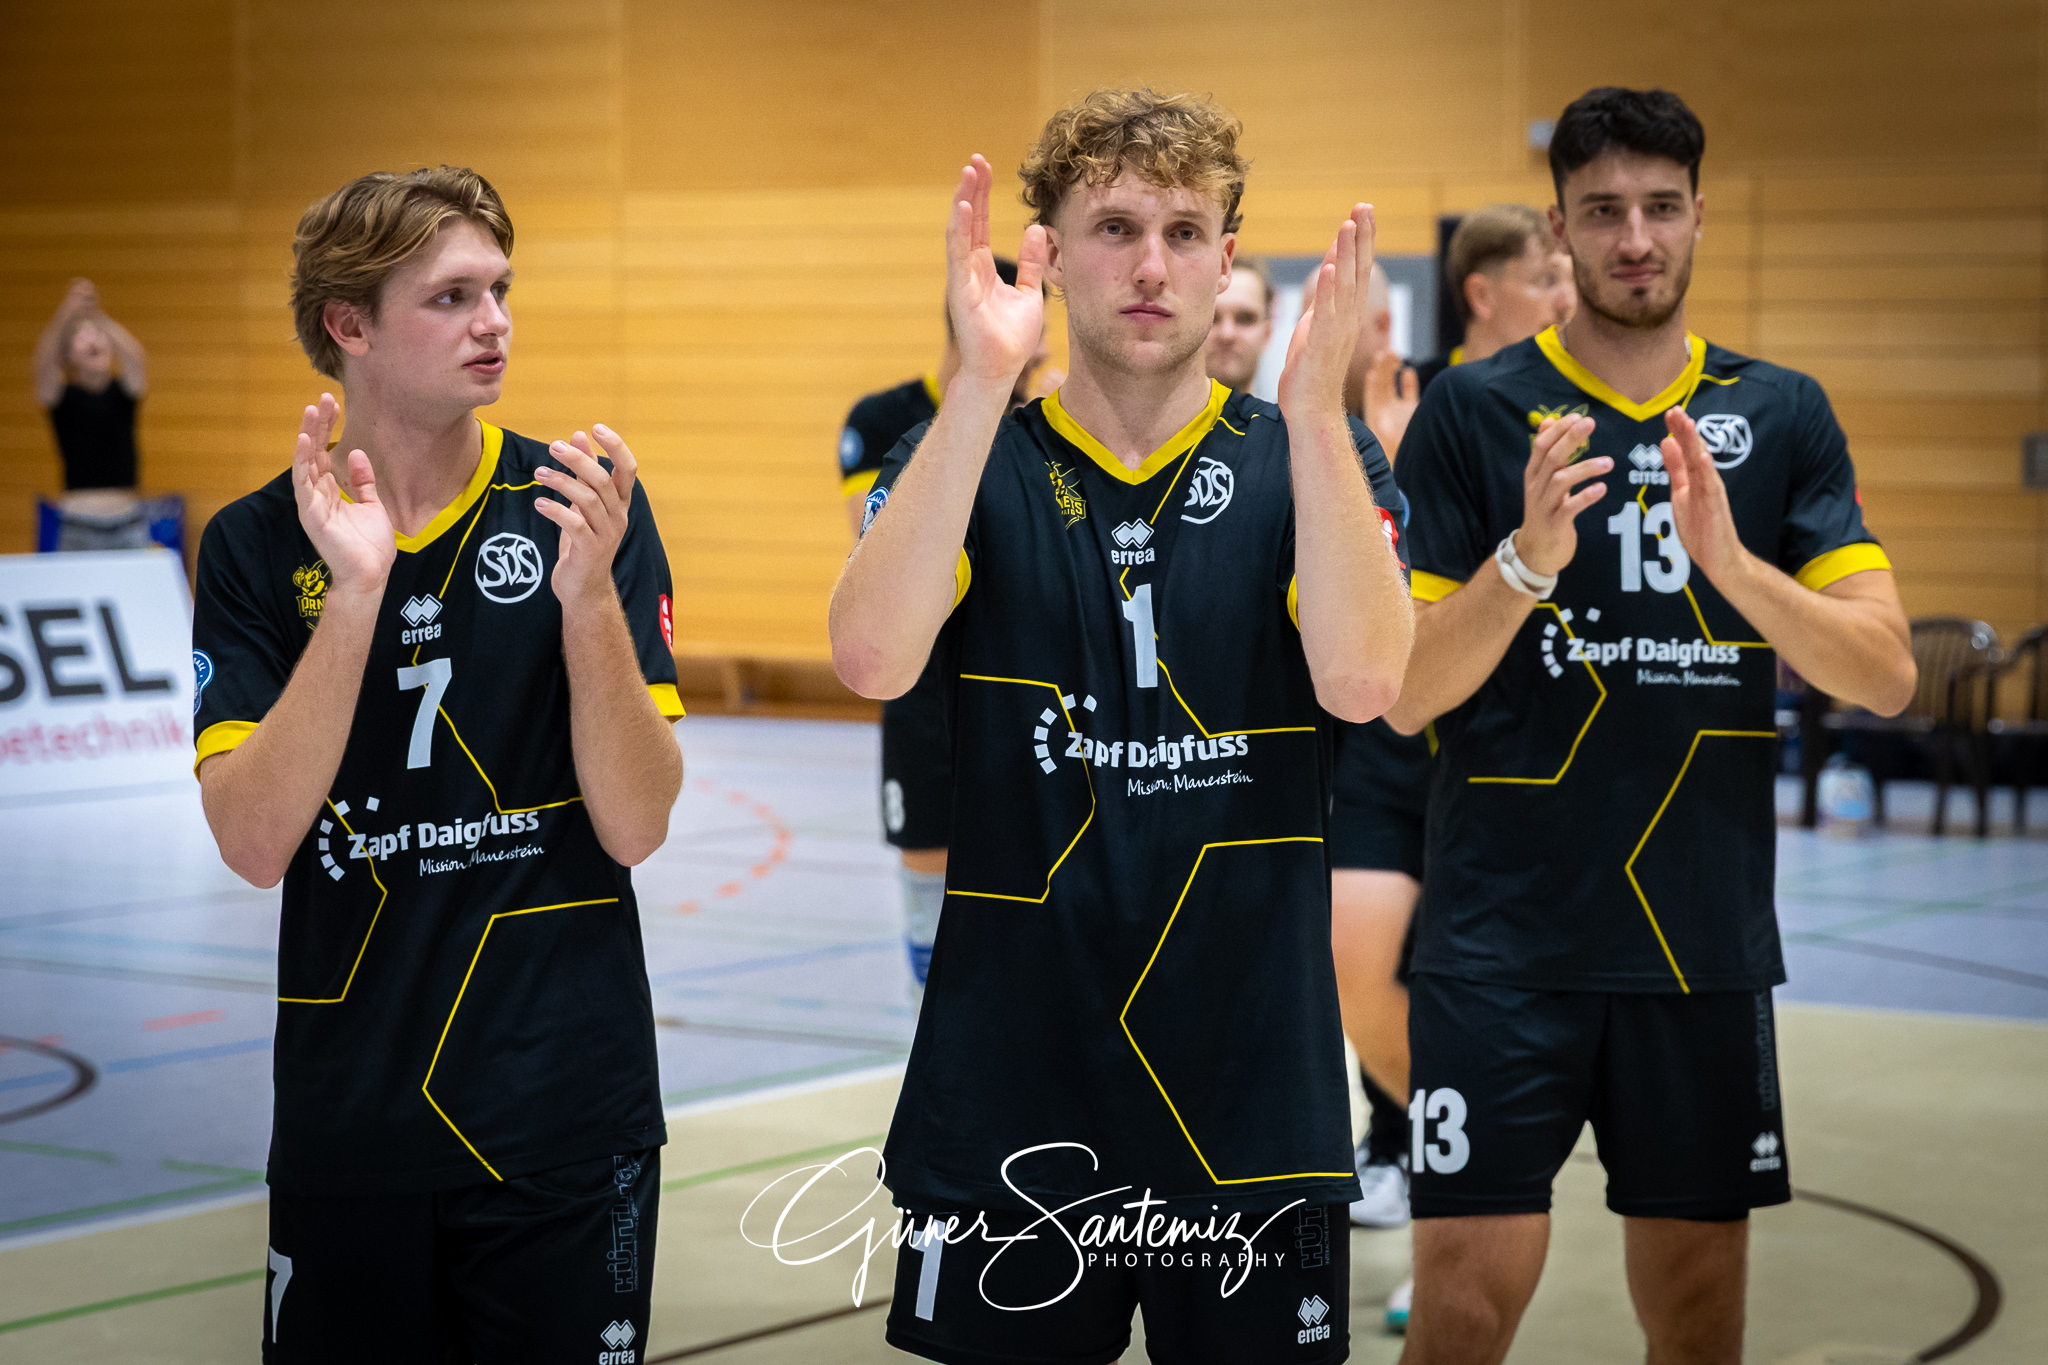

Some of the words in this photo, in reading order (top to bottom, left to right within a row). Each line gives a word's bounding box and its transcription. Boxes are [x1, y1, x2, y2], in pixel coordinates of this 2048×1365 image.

[1608, 501, 1691, 594] 13
[1121, 583, 1158, 688] 1
[1566, 637, 1633, 667] Zapf
[1636, 637, 1741, 668] Daigfuss
[0, 712, 190, 765] etechnik
[396, 657, 452, 770] 7
[1064, 731, 1124, 768] Zapf
[1127, 734, 1249, 770] Daigfuss
[347, 824, 411, 861] Zapf
[417, 810, 540, 849] Daigfuss
[1408, 1087, 1470, 1175] 13
[268, 1245, 293, 1344] 7
[914, 1219, 946, 1322] 1
